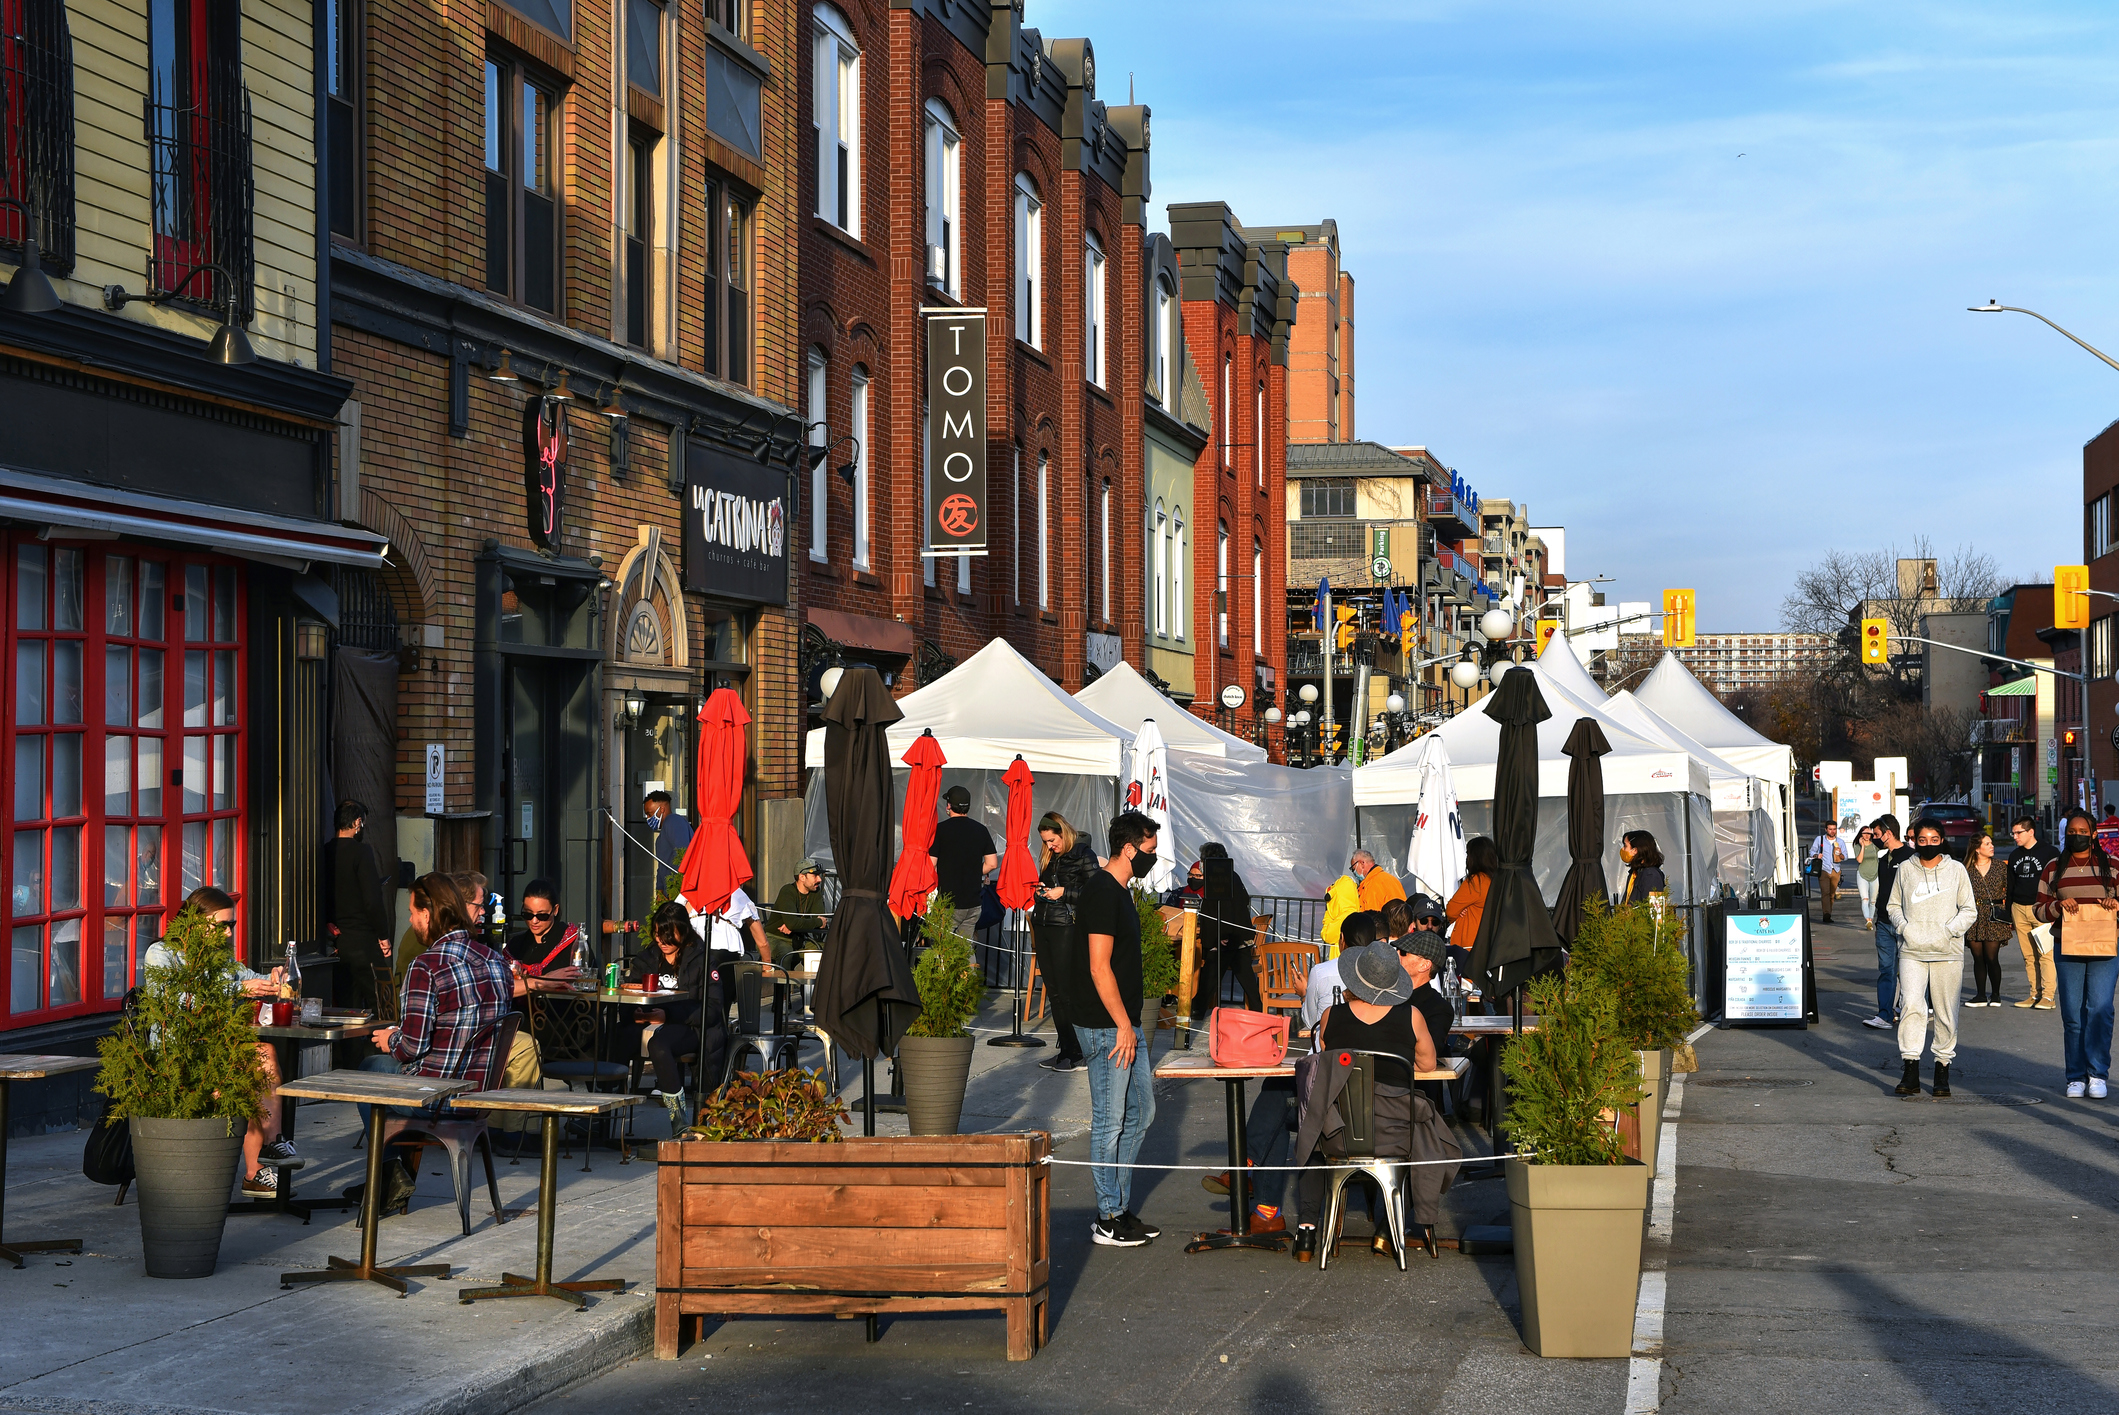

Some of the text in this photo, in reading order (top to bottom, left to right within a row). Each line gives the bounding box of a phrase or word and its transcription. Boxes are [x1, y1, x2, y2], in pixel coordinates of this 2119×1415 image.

[943, 326, 974, 482] TOMO
[693, 485, 768, 555] LA CATRINA
[1378, 531, 1386, 556] Parking
[708, 550, 734, 565] churros
[743, 557, 757, 569] café
[759, 560, 770, 572] bar
